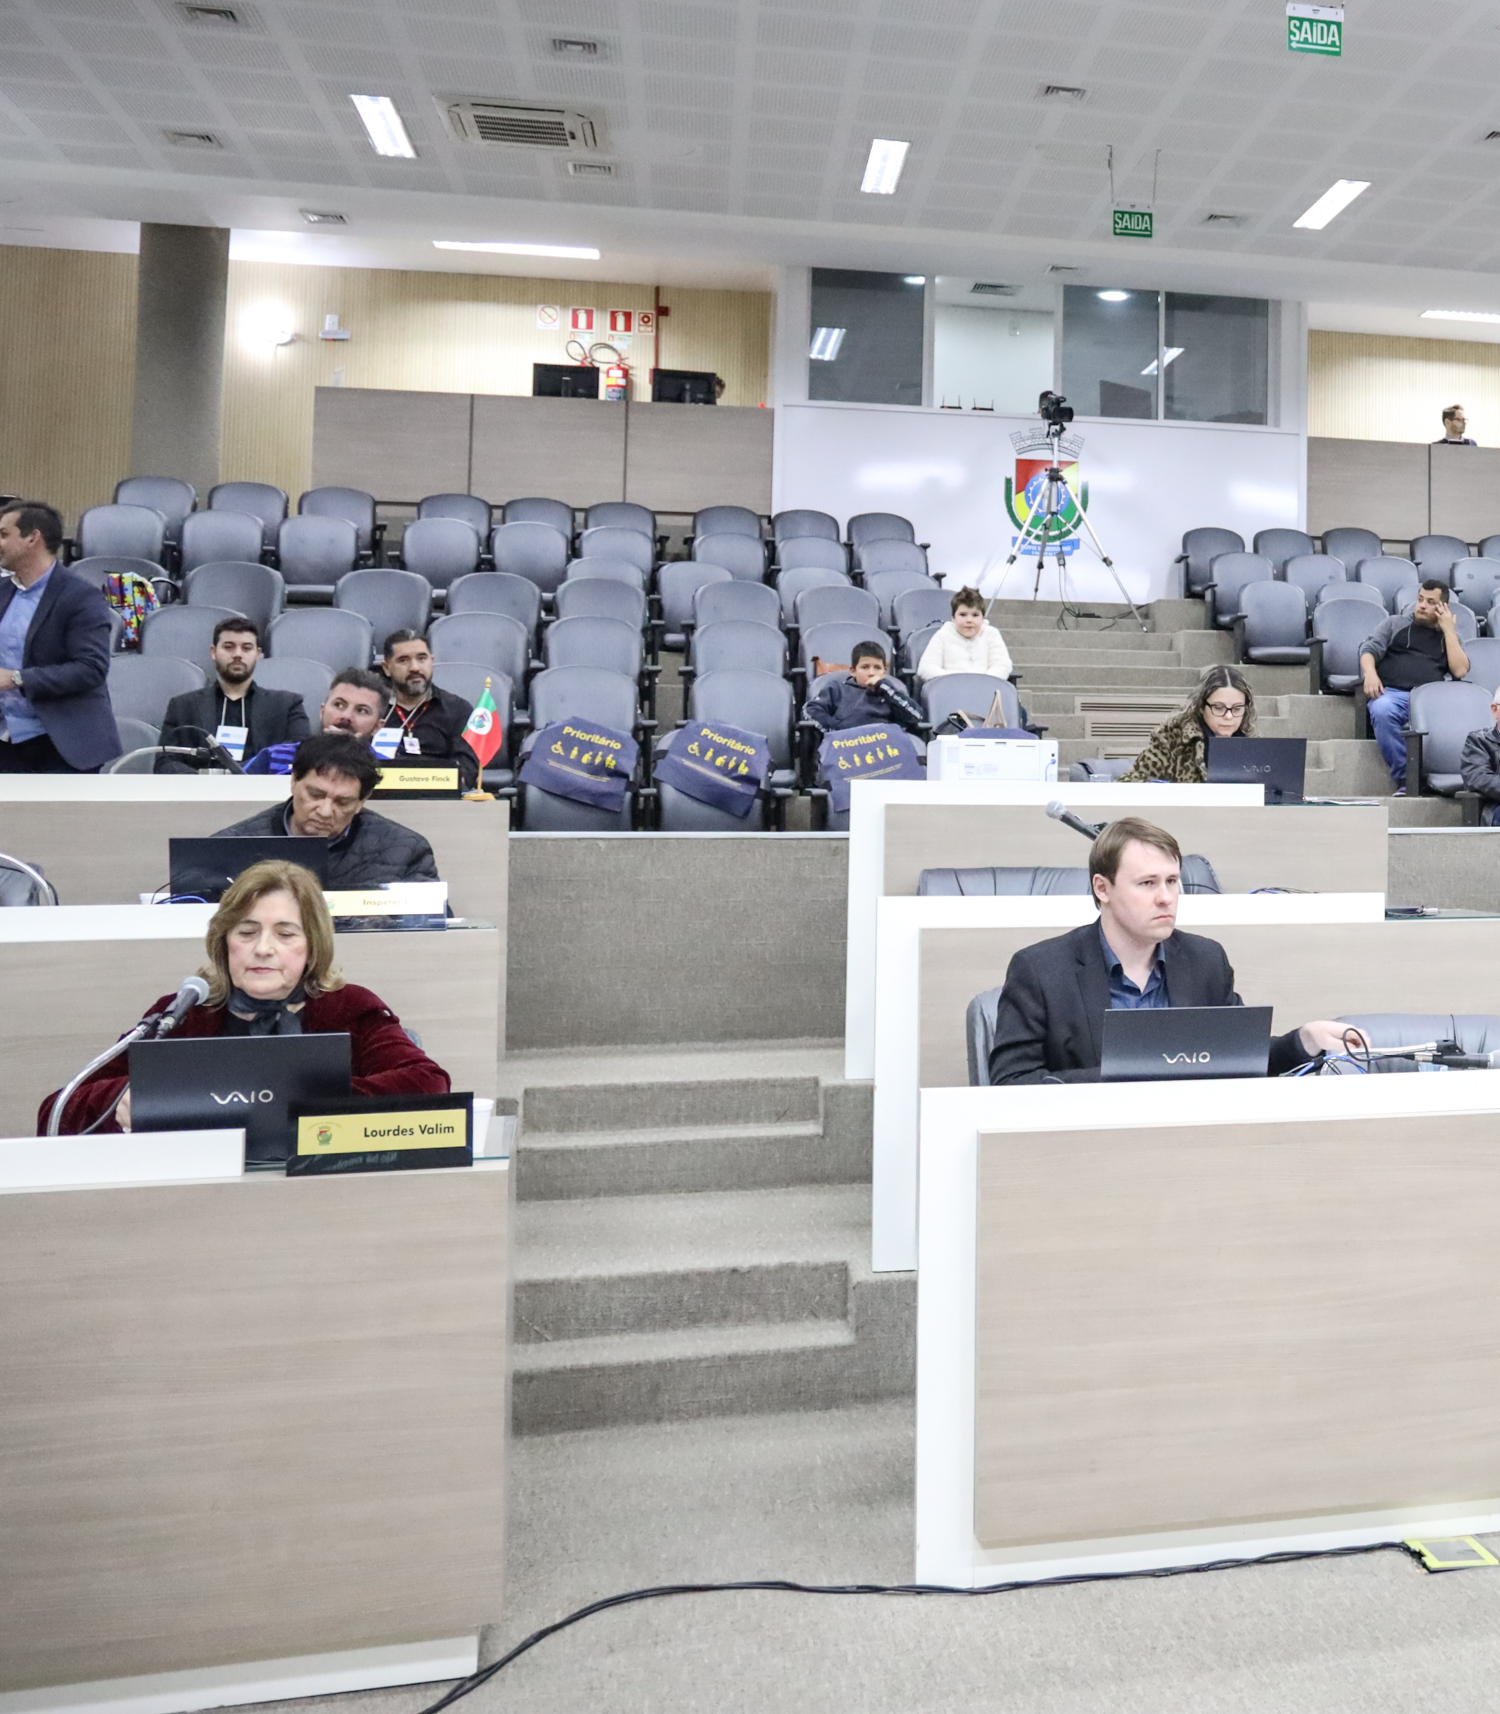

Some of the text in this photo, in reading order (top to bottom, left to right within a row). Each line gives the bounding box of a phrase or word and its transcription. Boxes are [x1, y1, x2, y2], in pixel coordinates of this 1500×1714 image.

[562, 726, 622, 750] Prioritário
[700, 728, 756, 755] Prioritário
[832, 732, 888, 749] Prioritário
[1243, 765, 1271, 773] VAIO
[1162, 1051, 1211, 1064] VAIO
[209, 1089, 274, 1105] VAIO
[363, 1123, 455, 1138] Lourdes Valim
